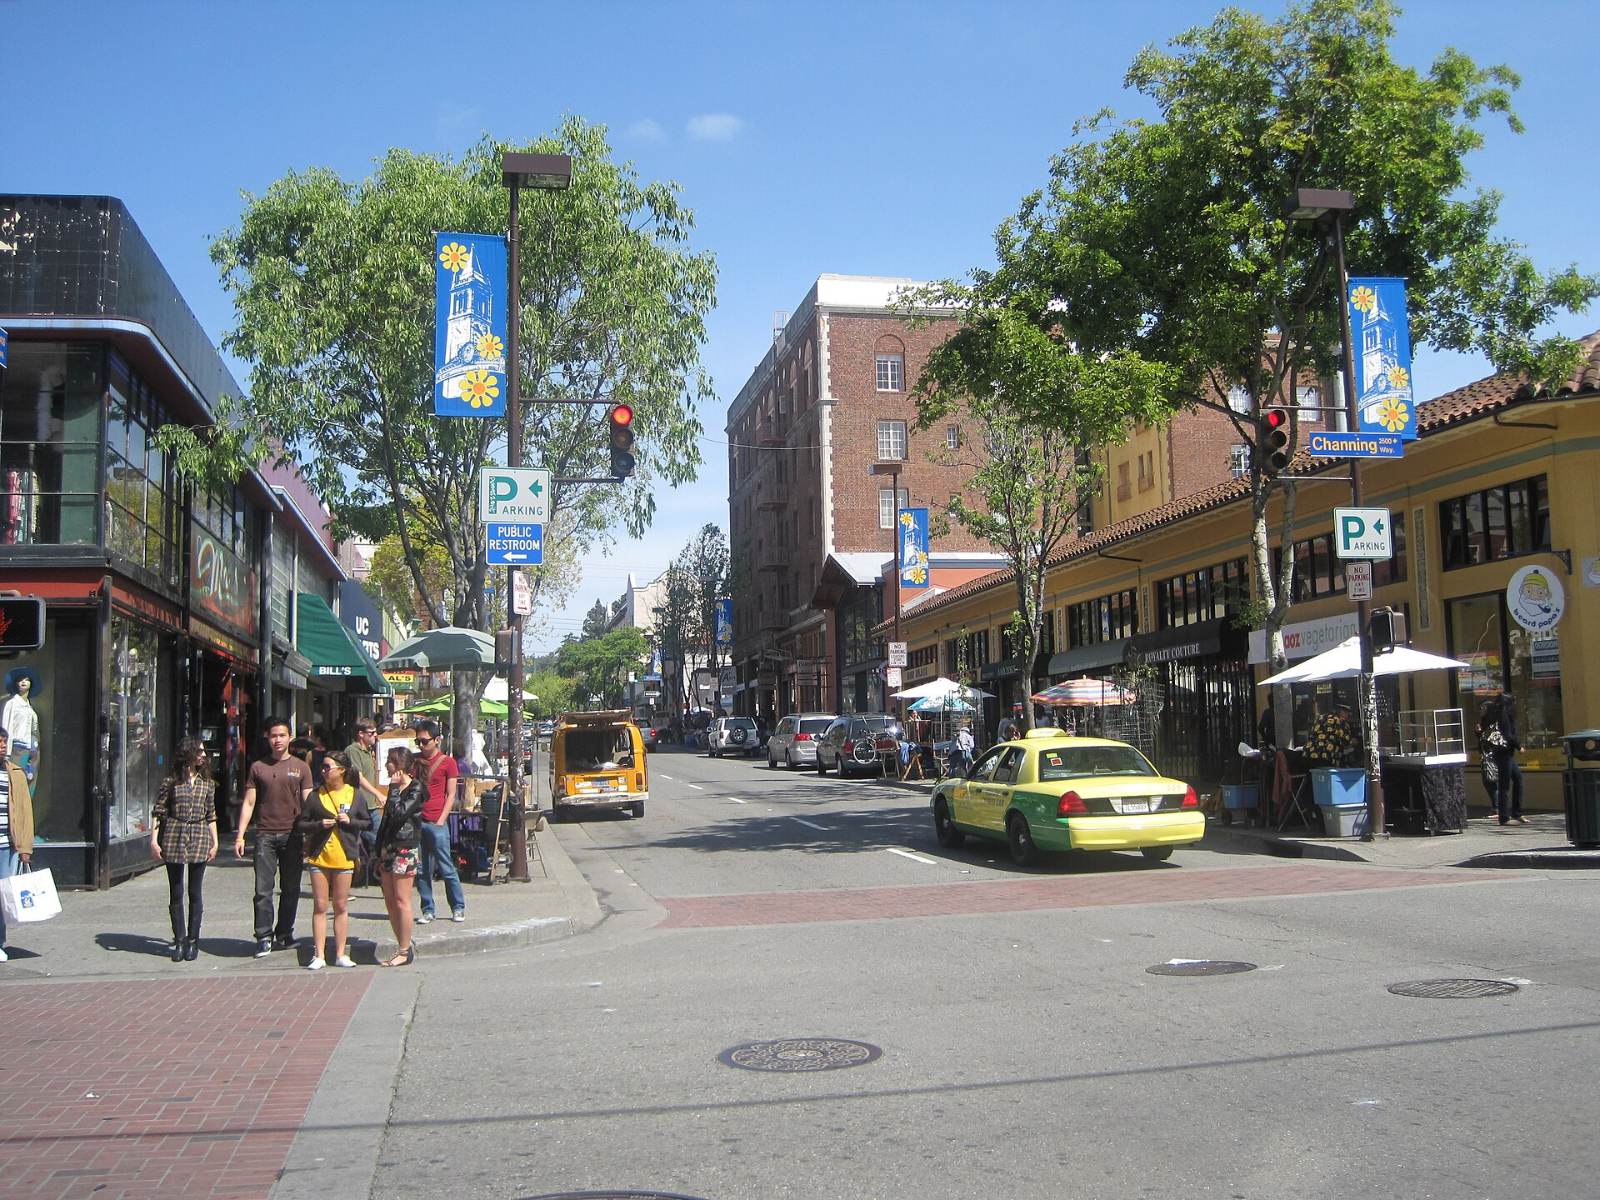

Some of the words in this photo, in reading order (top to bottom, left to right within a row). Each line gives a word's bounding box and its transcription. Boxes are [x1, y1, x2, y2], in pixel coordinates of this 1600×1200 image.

[1312, 436, 1378, 455] Channing
[498, 526, 532, 537] PUBLIC
[489, 540, 540, 551] RESTROOM
[1353, 566, 1363, 574] NO
[355, 616, 369, 636] UC
[1171, 643, 1201, 659] COUTURE
[318, 666, 352, 675] BILL'S
